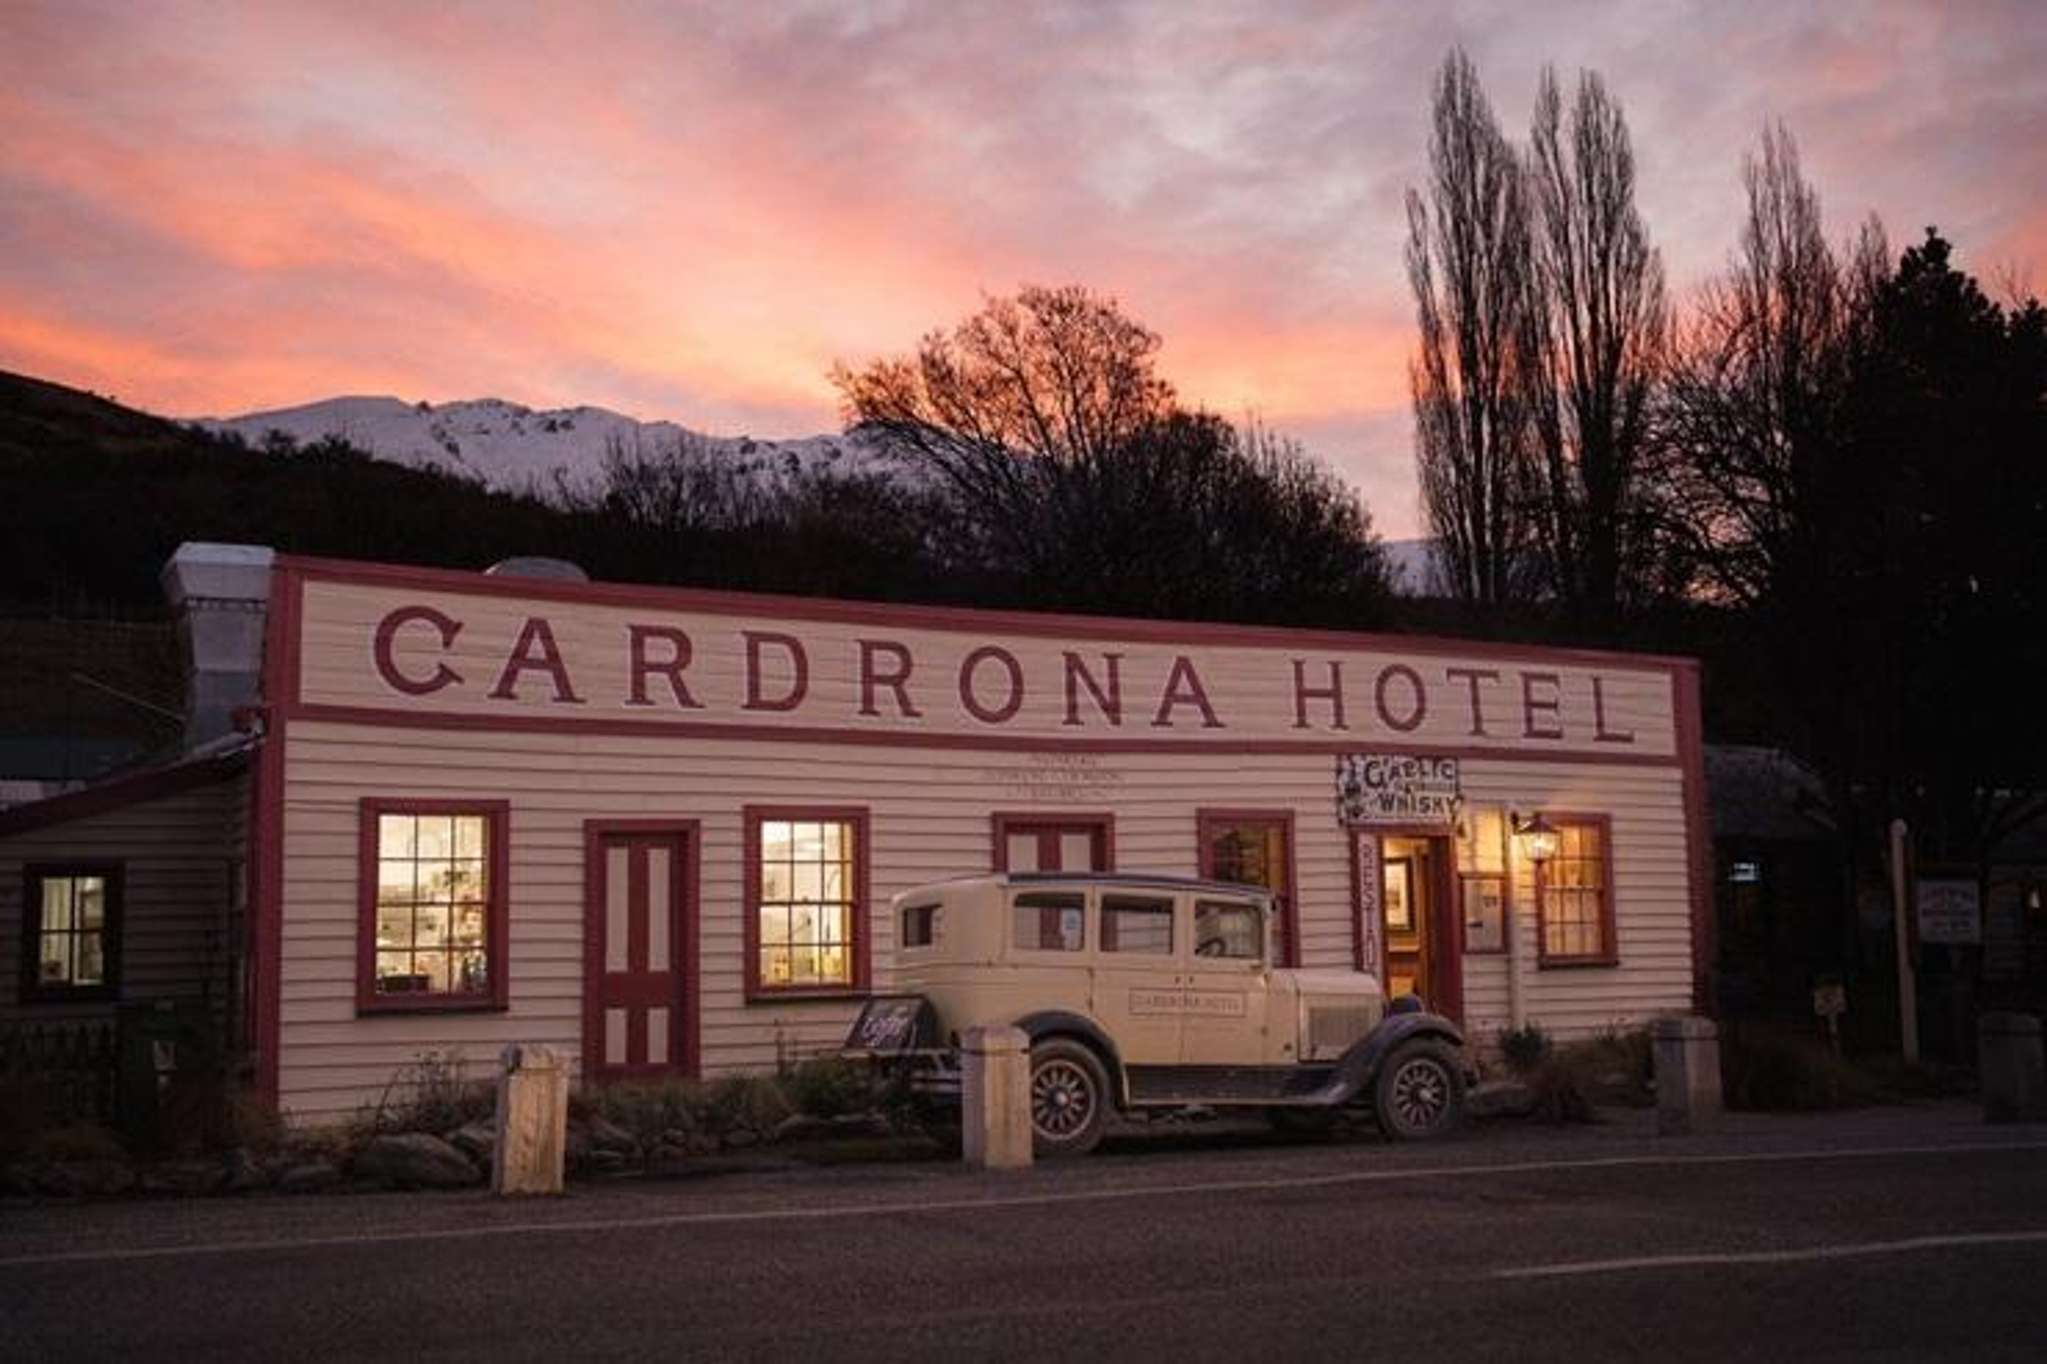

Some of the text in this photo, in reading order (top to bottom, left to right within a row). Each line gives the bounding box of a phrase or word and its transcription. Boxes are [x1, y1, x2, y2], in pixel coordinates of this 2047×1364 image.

[372, 604, 1636, 745] CARDRONA HOTEL
[1378, 793, 1464, 824] WHISKY
